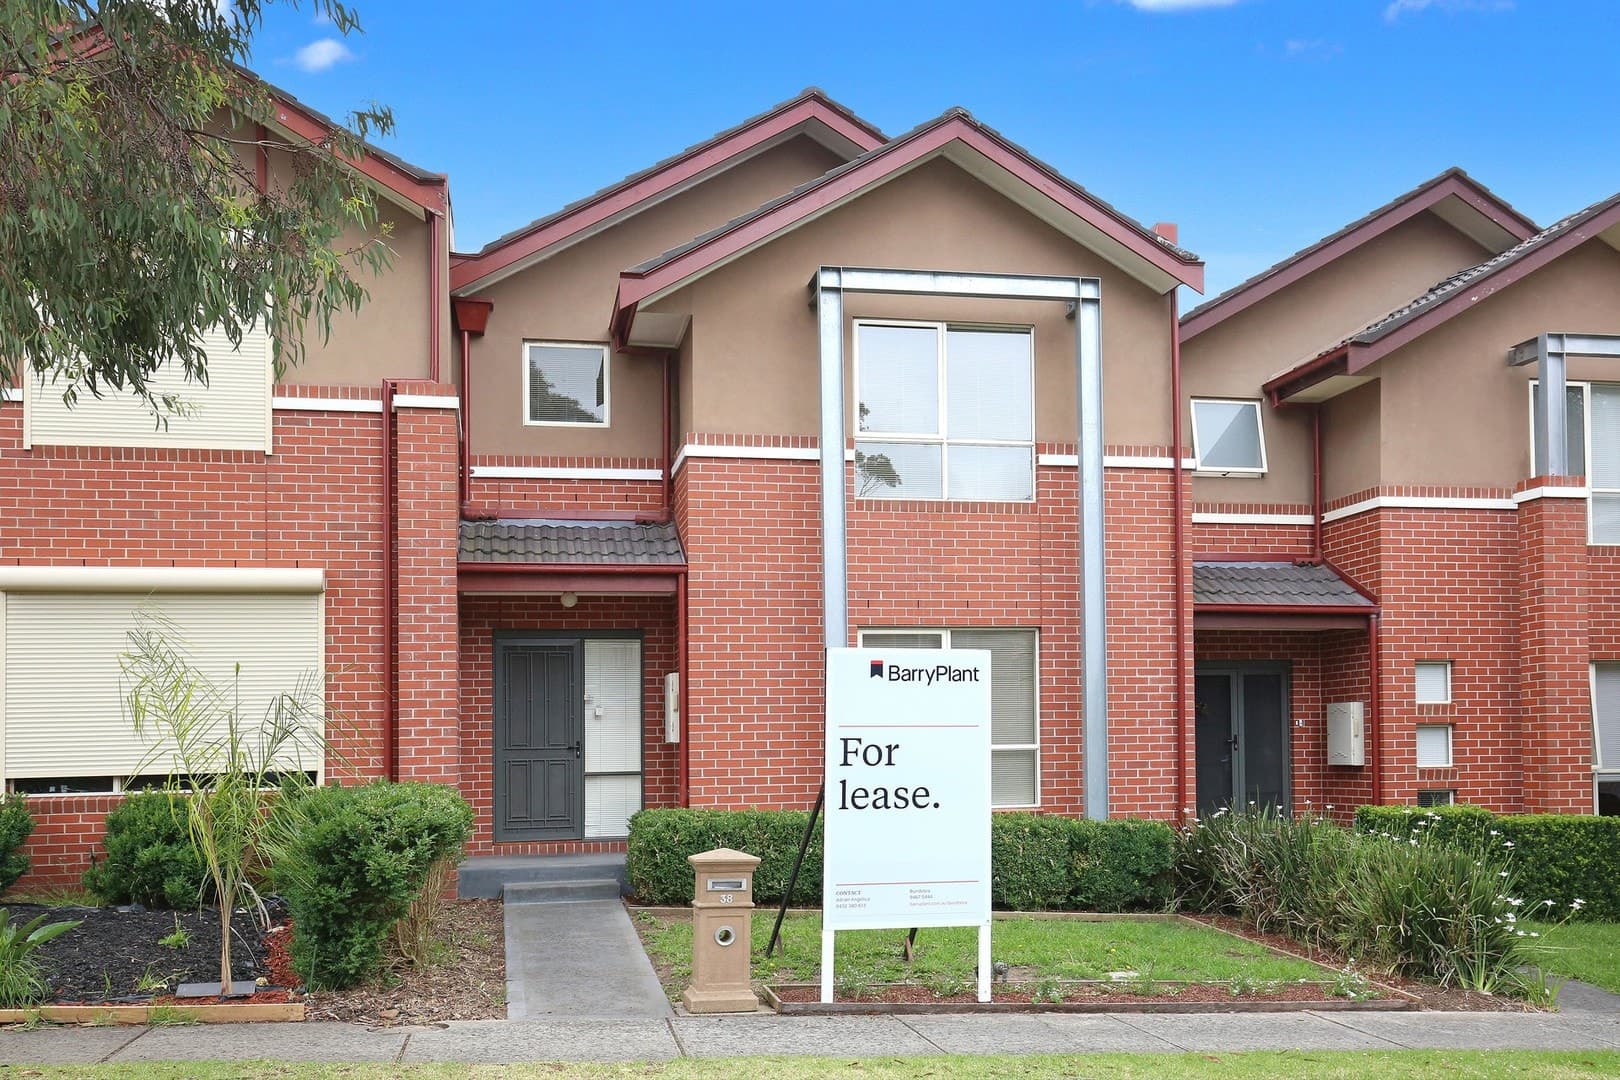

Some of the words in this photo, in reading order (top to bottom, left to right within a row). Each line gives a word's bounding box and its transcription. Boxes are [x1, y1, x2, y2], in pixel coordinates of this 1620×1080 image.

[888, 665, 980, 686] BarryPlant
[839, 737, 900, 767] For
[838, 779, 940, 810] lease.
[720, 894, 733, 904] 38
